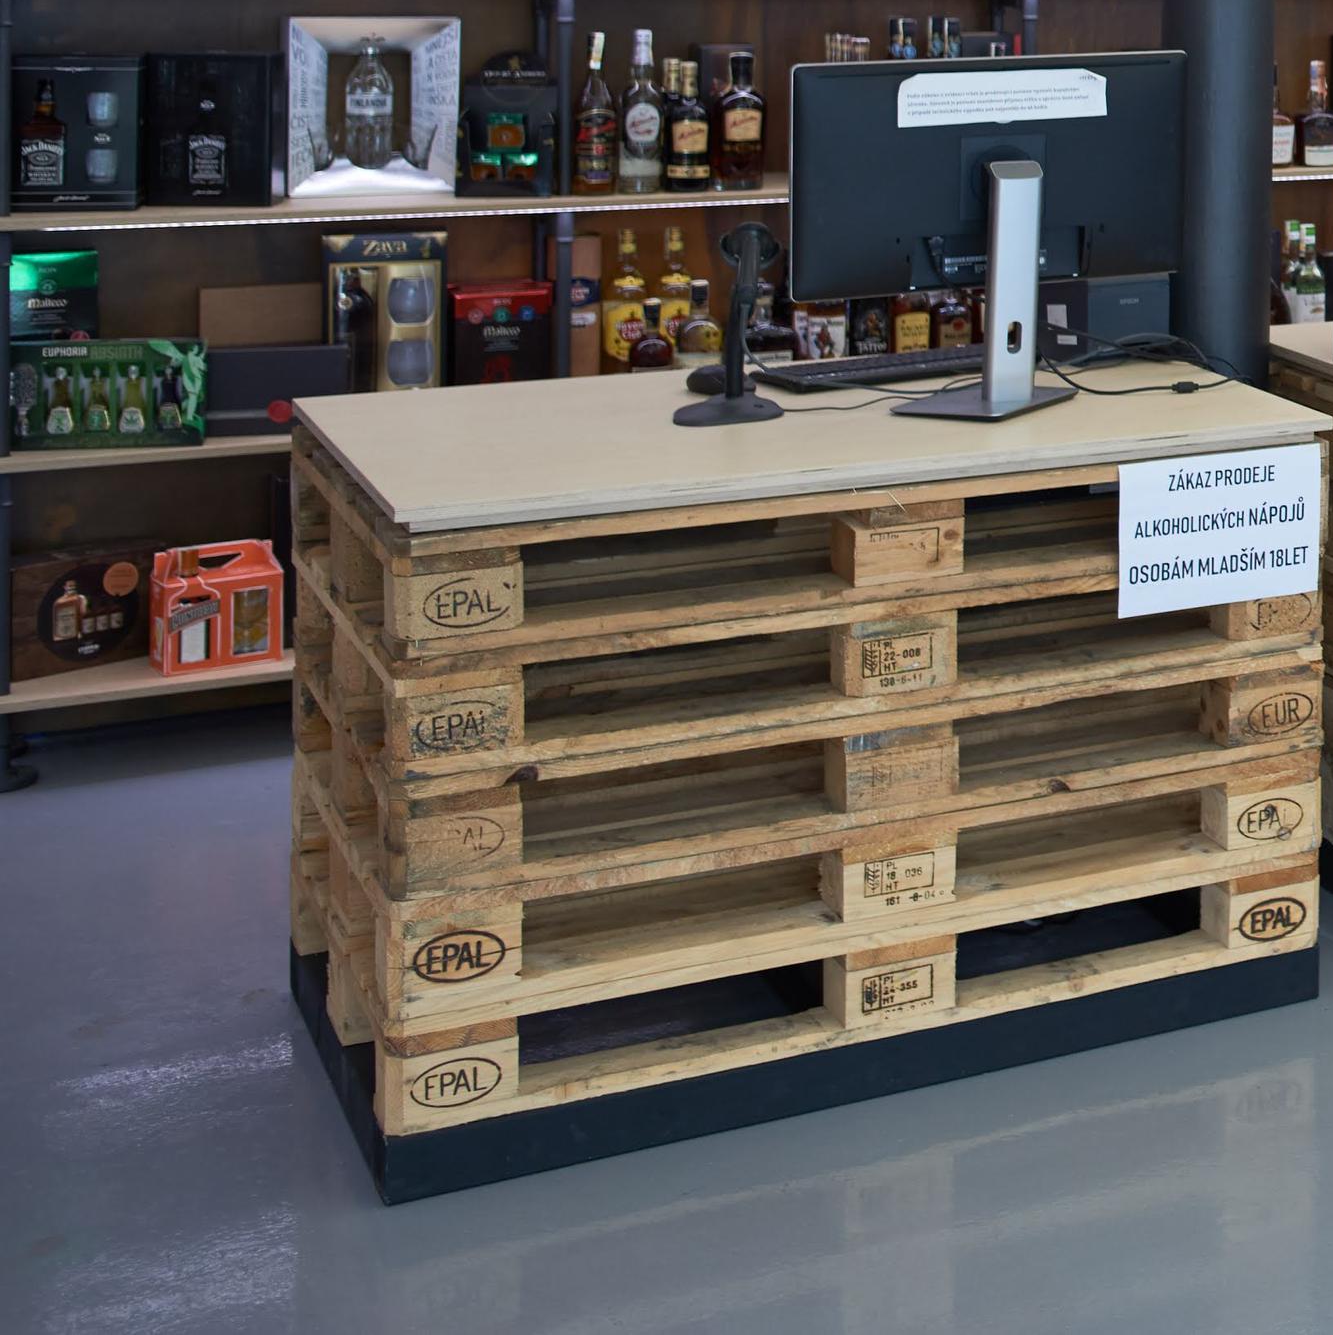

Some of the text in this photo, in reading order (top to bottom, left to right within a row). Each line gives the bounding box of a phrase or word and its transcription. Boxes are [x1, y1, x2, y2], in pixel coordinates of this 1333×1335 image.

[362, 239, 409, 258] Zaya
[42, 345, 144, 360] EUPHORIA ABSINTH
[1168, 464, 1276, 492] ZÁKAZ PRODEJE
[1134, 495, 1306, 539] ALKOHOLICKÝCH NÁPOJŮ
[1128, 545, 1309, 585] OSOBÁM MLADŠÍM 18LET
[436, 586, 503, 619] EPAL
[884, 662, 896, 672] HT
[1262, 699, 1300, 728] EUR
[885, 881, 899, 891] HT
[1250, 901, 1299, 933] EPAL
[426, 939, 492, 976] EPAL
